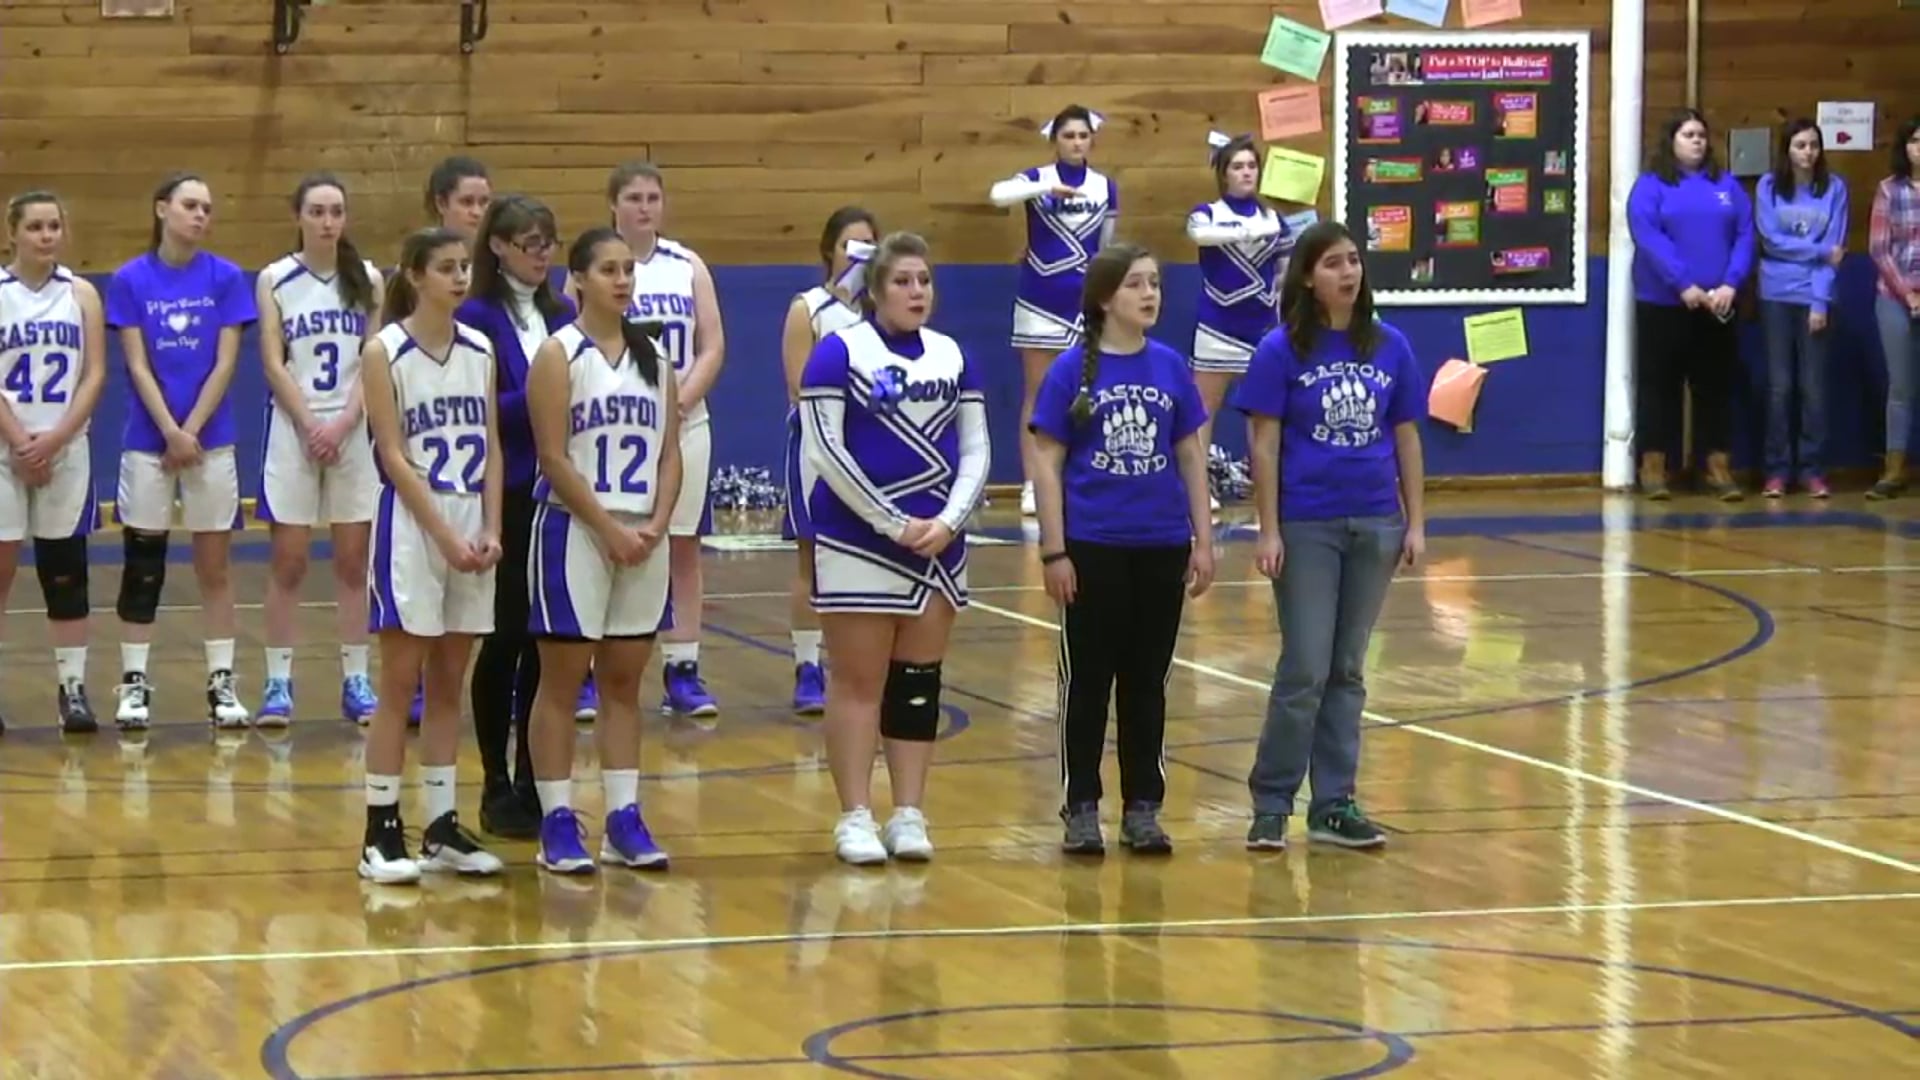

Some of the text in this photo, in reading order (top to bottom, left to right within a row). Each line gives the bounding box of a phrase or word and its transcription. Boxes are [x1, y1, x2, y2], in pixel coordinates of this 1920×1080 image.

[624, 294, 694, 318] ASTON
[5, 352, 68, 403] 42
[313, 342, 339, 391] 3
[1298, 361, 1393, 388] EASTON
[422, 434, 485, 493] 22
[594, 434, 648, 495] 12
[1090, 451, 1168, 475] BAND
